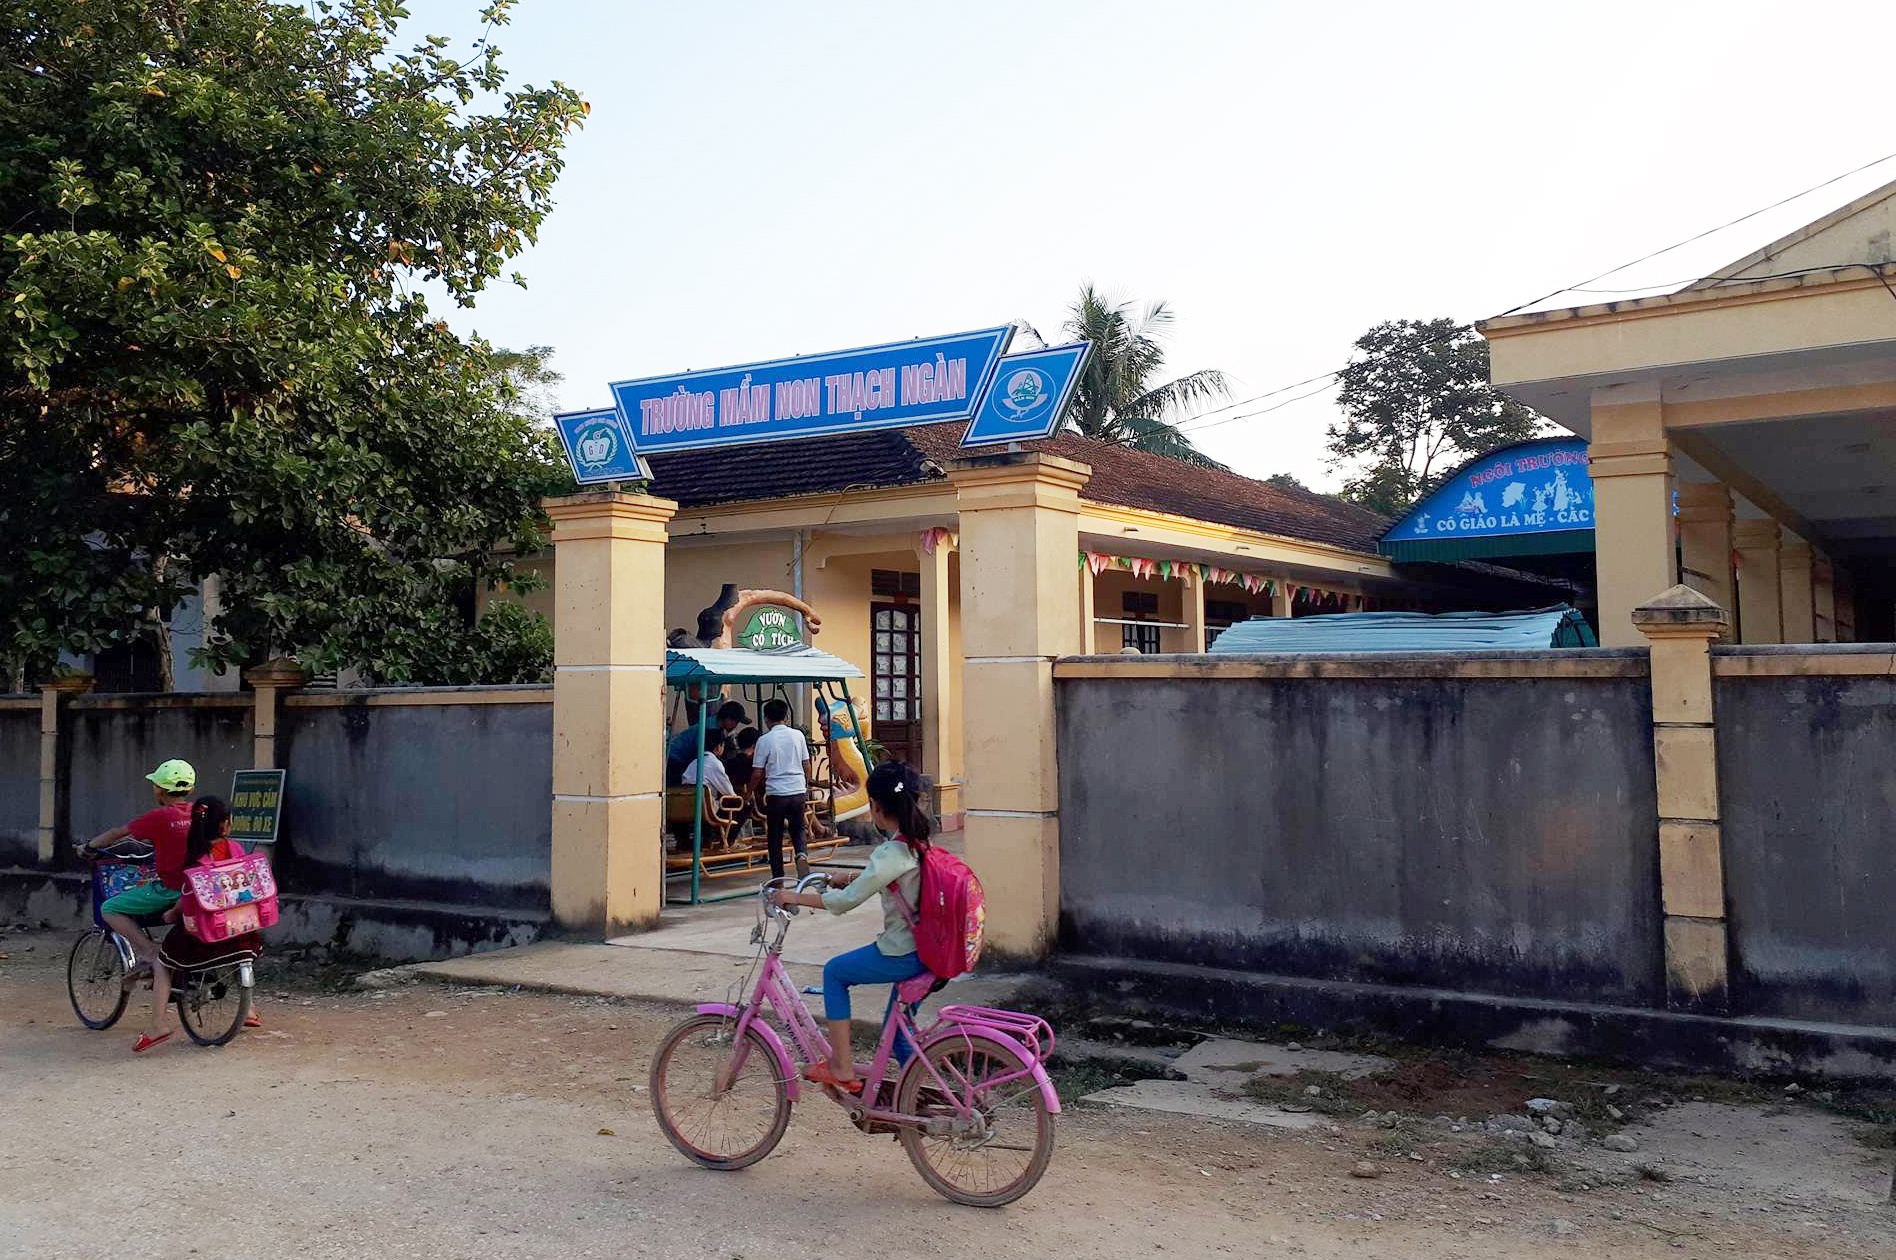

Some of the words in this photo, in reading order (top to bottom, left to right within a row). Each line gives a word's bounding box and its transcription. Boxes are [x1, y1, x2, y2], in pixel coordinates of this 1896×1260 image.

[640, 385, 714, 436] TRƯỜNG
[719, 374, 771, 427] MẦM
[775, 378, 820, 421] NON
[825, 367, 896, 421] THẠCH
[900, 352, 967, 406] NGÀN
[1470, 462, 1513, 489] NGÔI
[1437, 516, 1456, 531] CÔ
[1460, 514, 1497, 530] GIÁO
[1501, 511, 1520, 527] LÀ
[1524, 511, 1546, 528] MẸ
[1557, 507, 1590, 523] CÁC
[760, 611, 786, 628] VƯỜN
